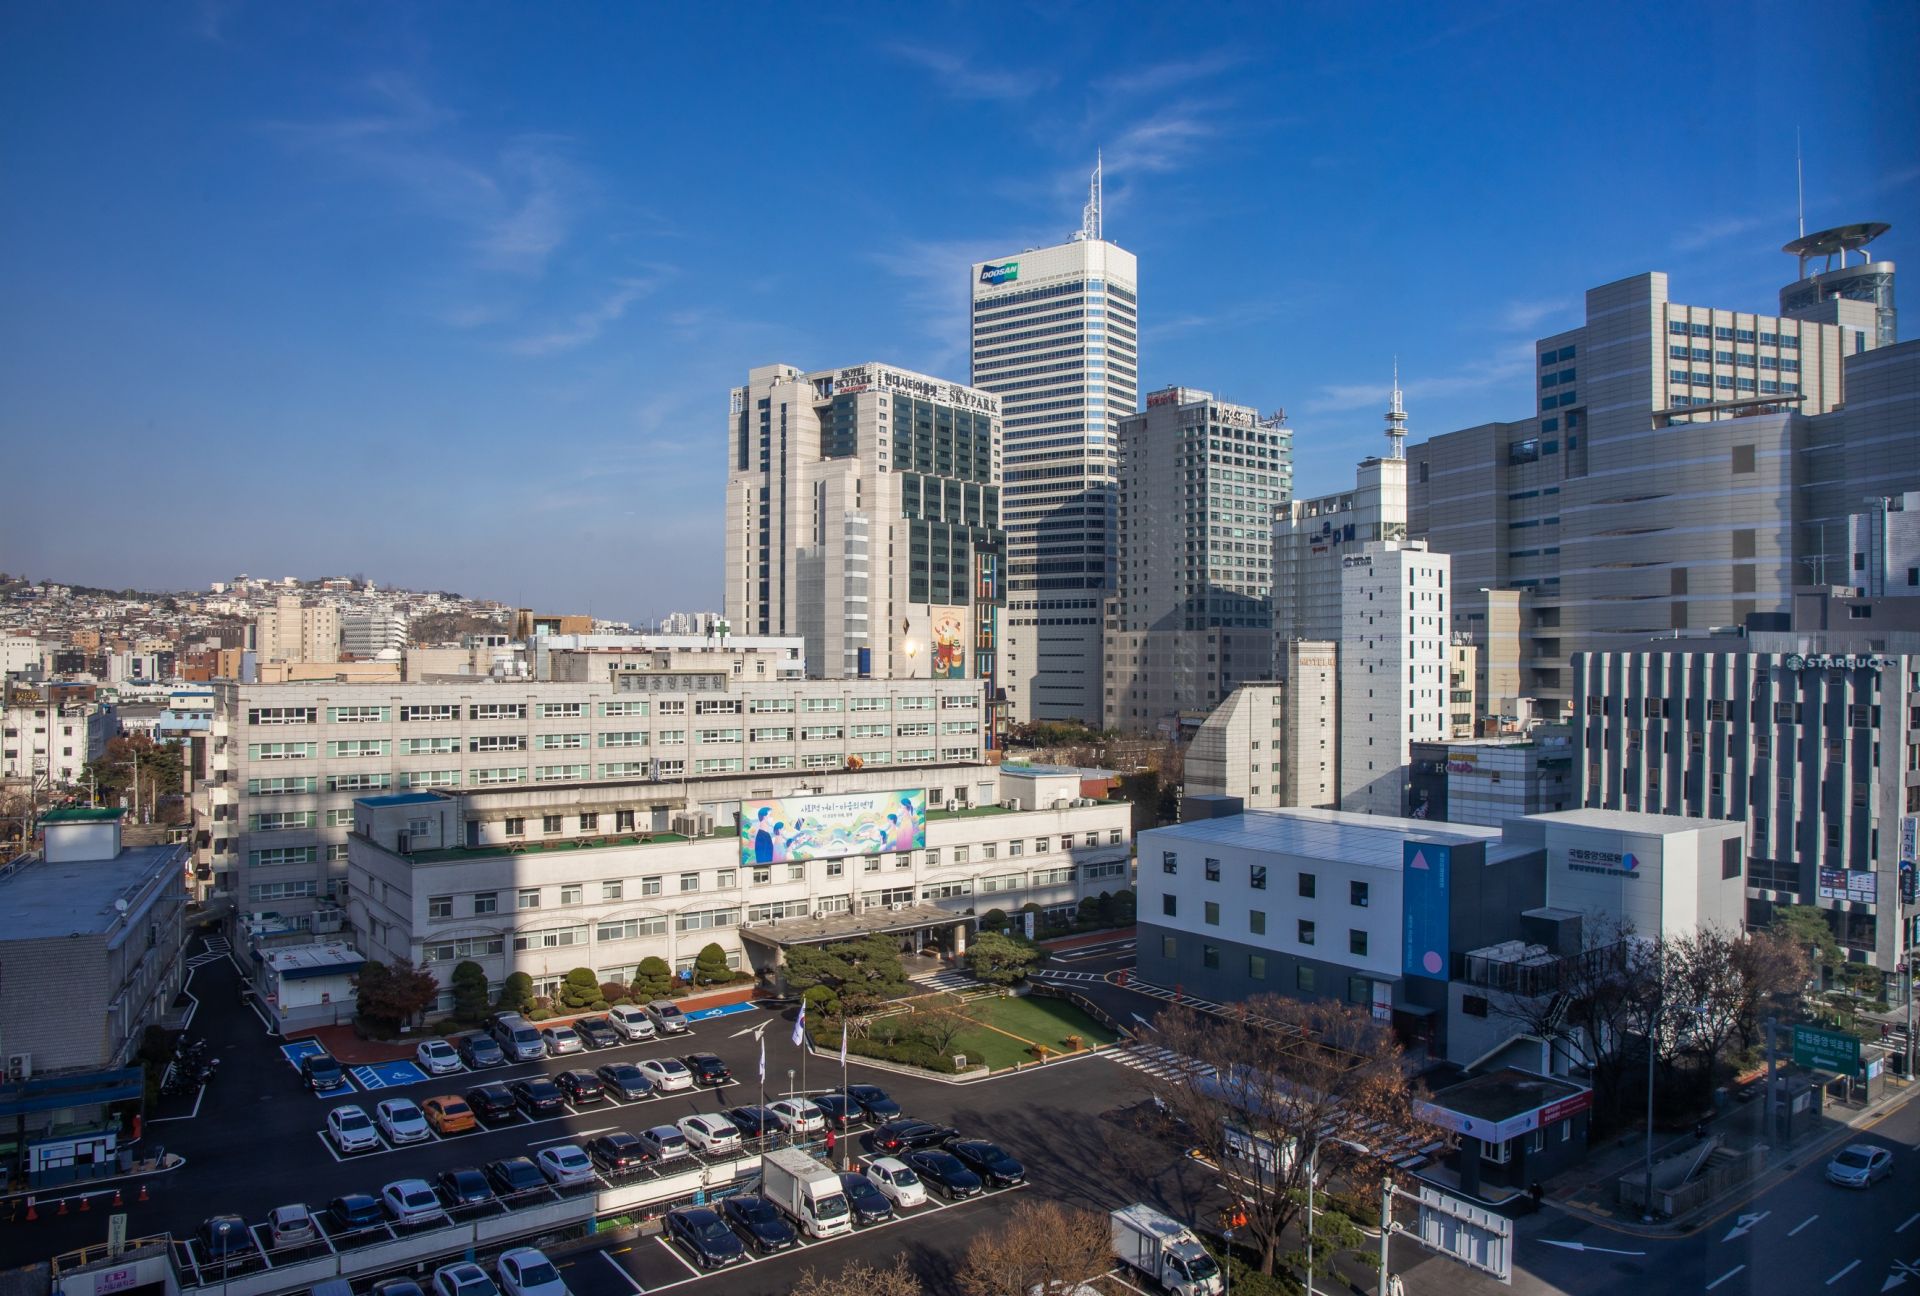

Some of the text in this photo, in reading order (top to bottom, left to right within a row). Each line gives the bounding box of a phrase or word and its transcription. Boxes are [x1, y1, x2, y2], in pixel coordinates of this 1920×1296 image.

[982, 265, 1018, 279] DOOSAN
[841, 367, 867, 378] HOTEL
[834, 375, 873, 389] SKYPARK
[885, 372, 937, 397] 현대시티아울렛
[949, 390, 997, 413] SKYPARK
[1807, 657, 1898, 668] STARBUCKS
[621, 676, 722, 690] 국립중앙의료원
[1568, 848, 1622, 863] 국립중앙의료원
[1797, 1031, 1853, 1053] 국립중앙의료원
